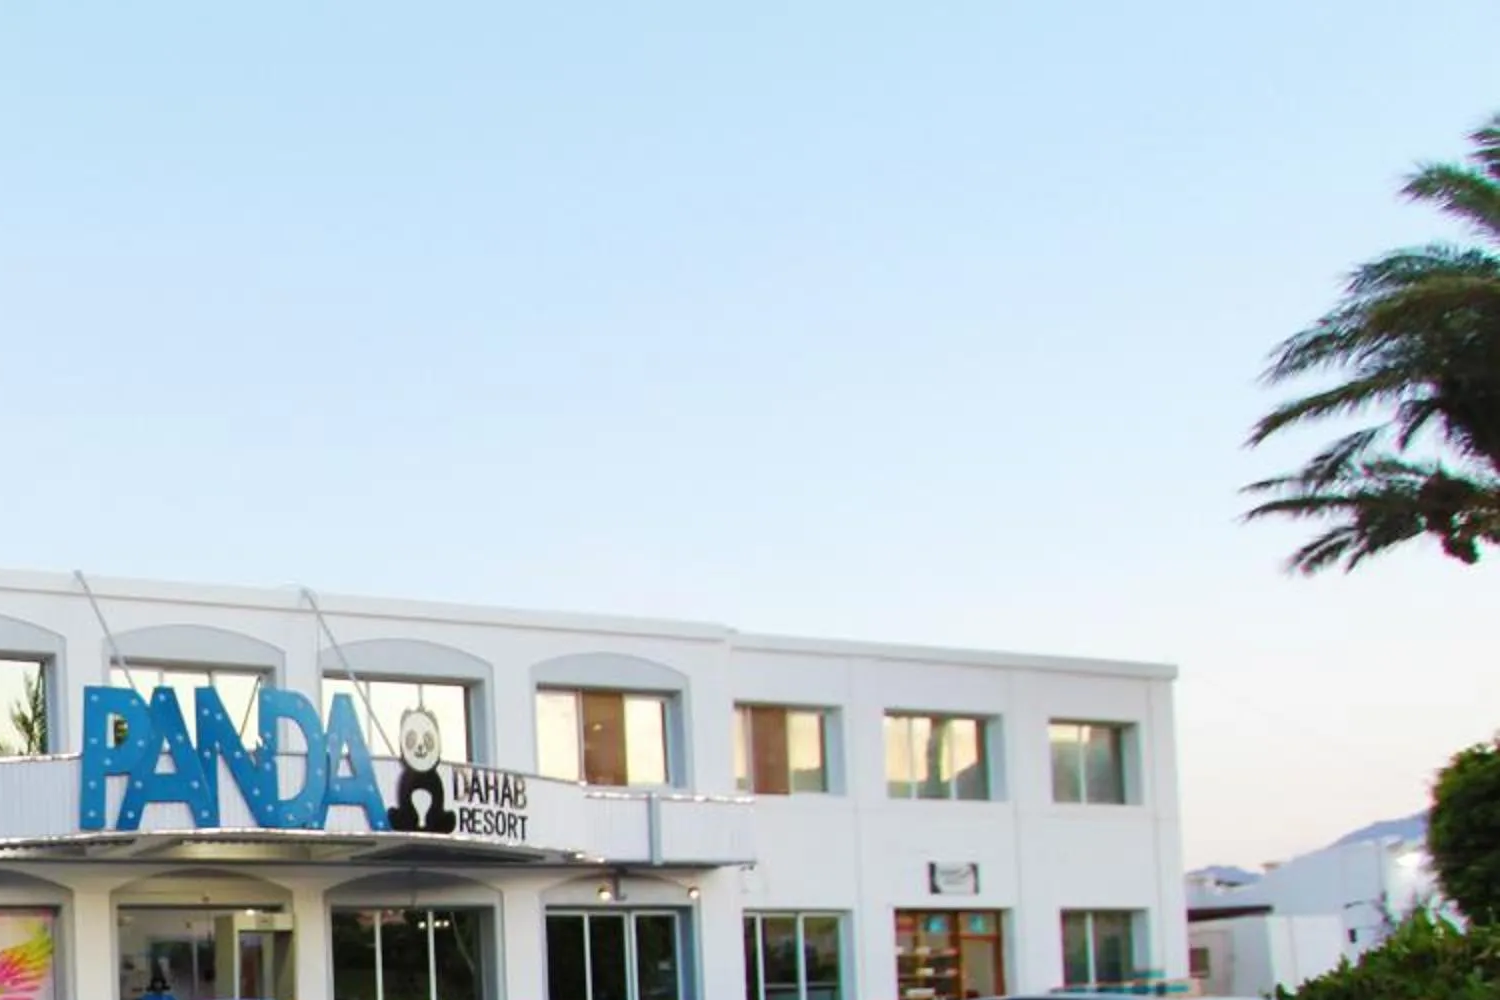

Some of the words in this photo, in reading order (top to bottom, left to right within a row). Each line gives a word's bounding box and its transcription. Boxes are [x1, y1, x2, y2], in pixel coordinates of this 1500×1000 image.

[80, 686, 391, 831] PANDA
[453, 771, 527, 810] DAHAB
[459, 807, 528, 841] RESORT
